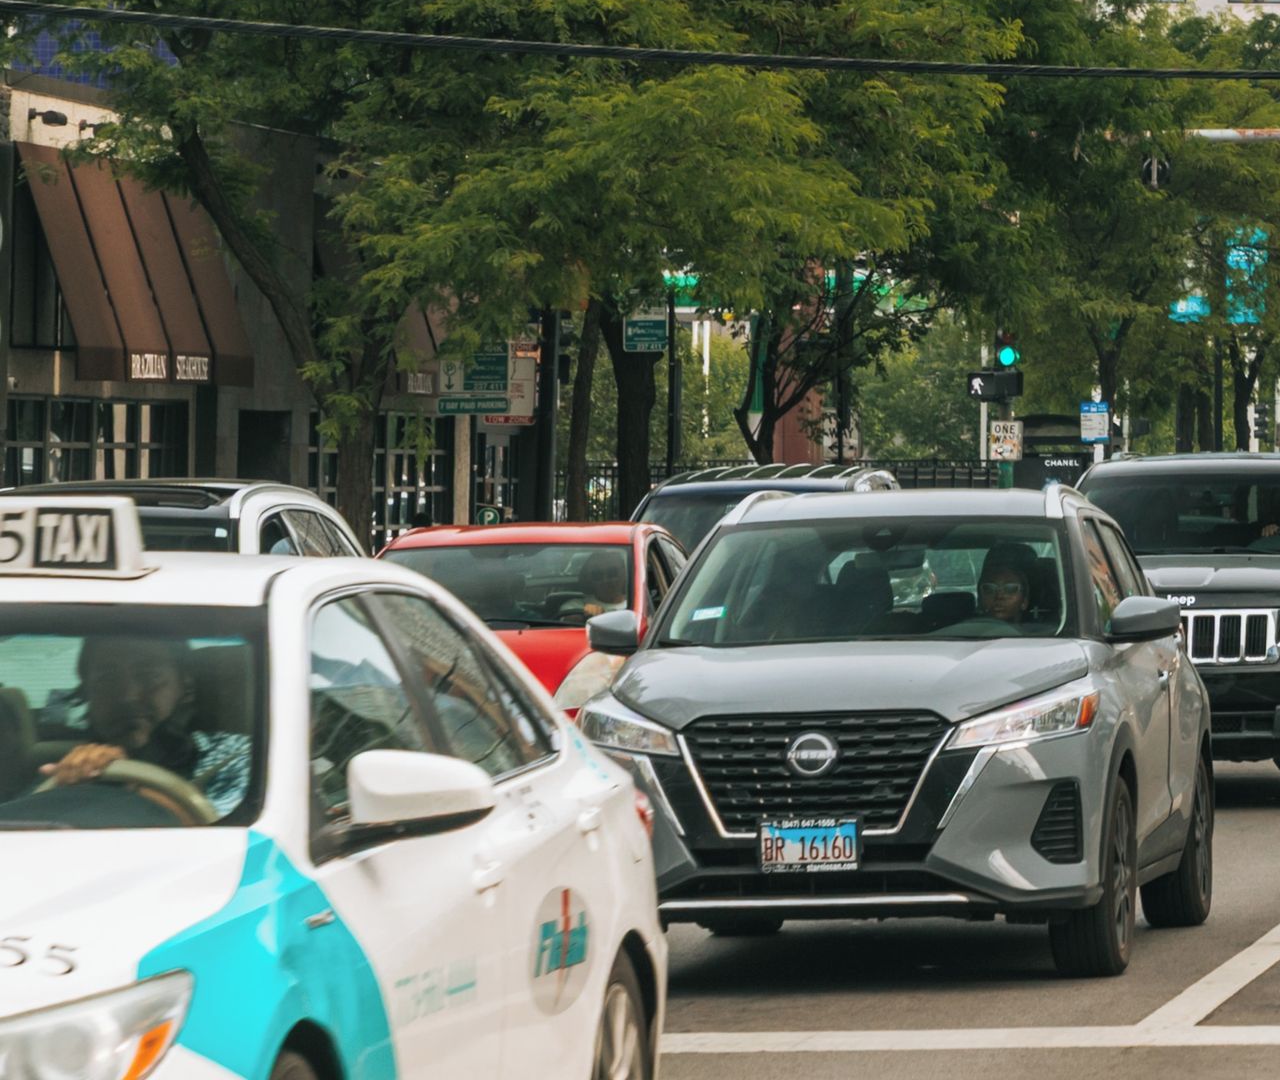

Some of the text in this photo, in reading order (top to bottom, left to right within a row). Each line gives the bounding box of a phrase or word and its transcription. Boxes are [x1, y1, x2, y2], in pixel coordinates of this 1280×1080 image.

[994, 424, 1016, 434] ONE
[1044, 459, 1079, 467] CHANEL
[37, 513, 110, 563] TAXI
[799, 835, 853, 861] 16160
